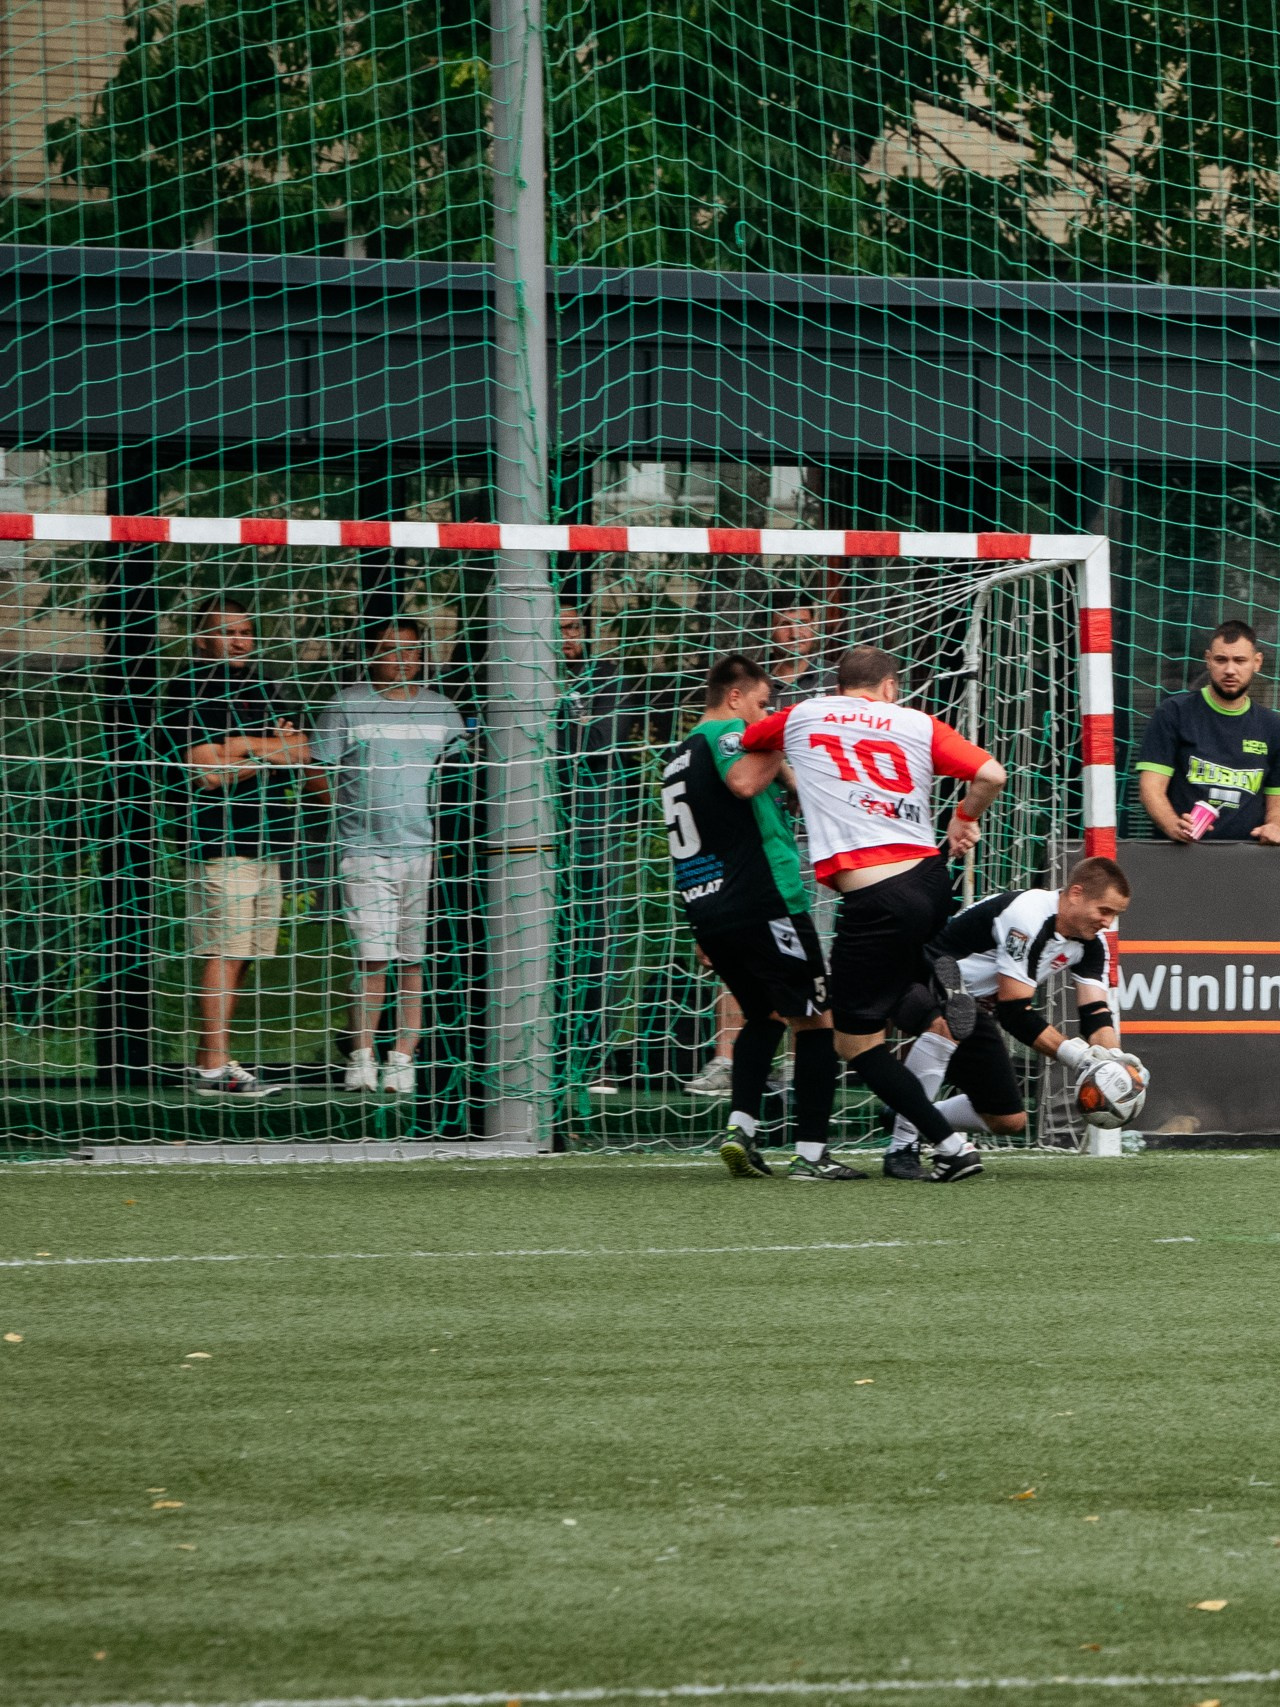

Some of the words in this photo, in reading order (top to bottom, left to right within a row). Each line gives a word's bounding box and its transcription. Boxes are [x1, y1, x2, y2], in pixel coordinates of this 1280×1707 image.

[809, 733, 916, 795] 10
[661, 781, 702, 860] 5
[813, 976, 827, 1003] 5
